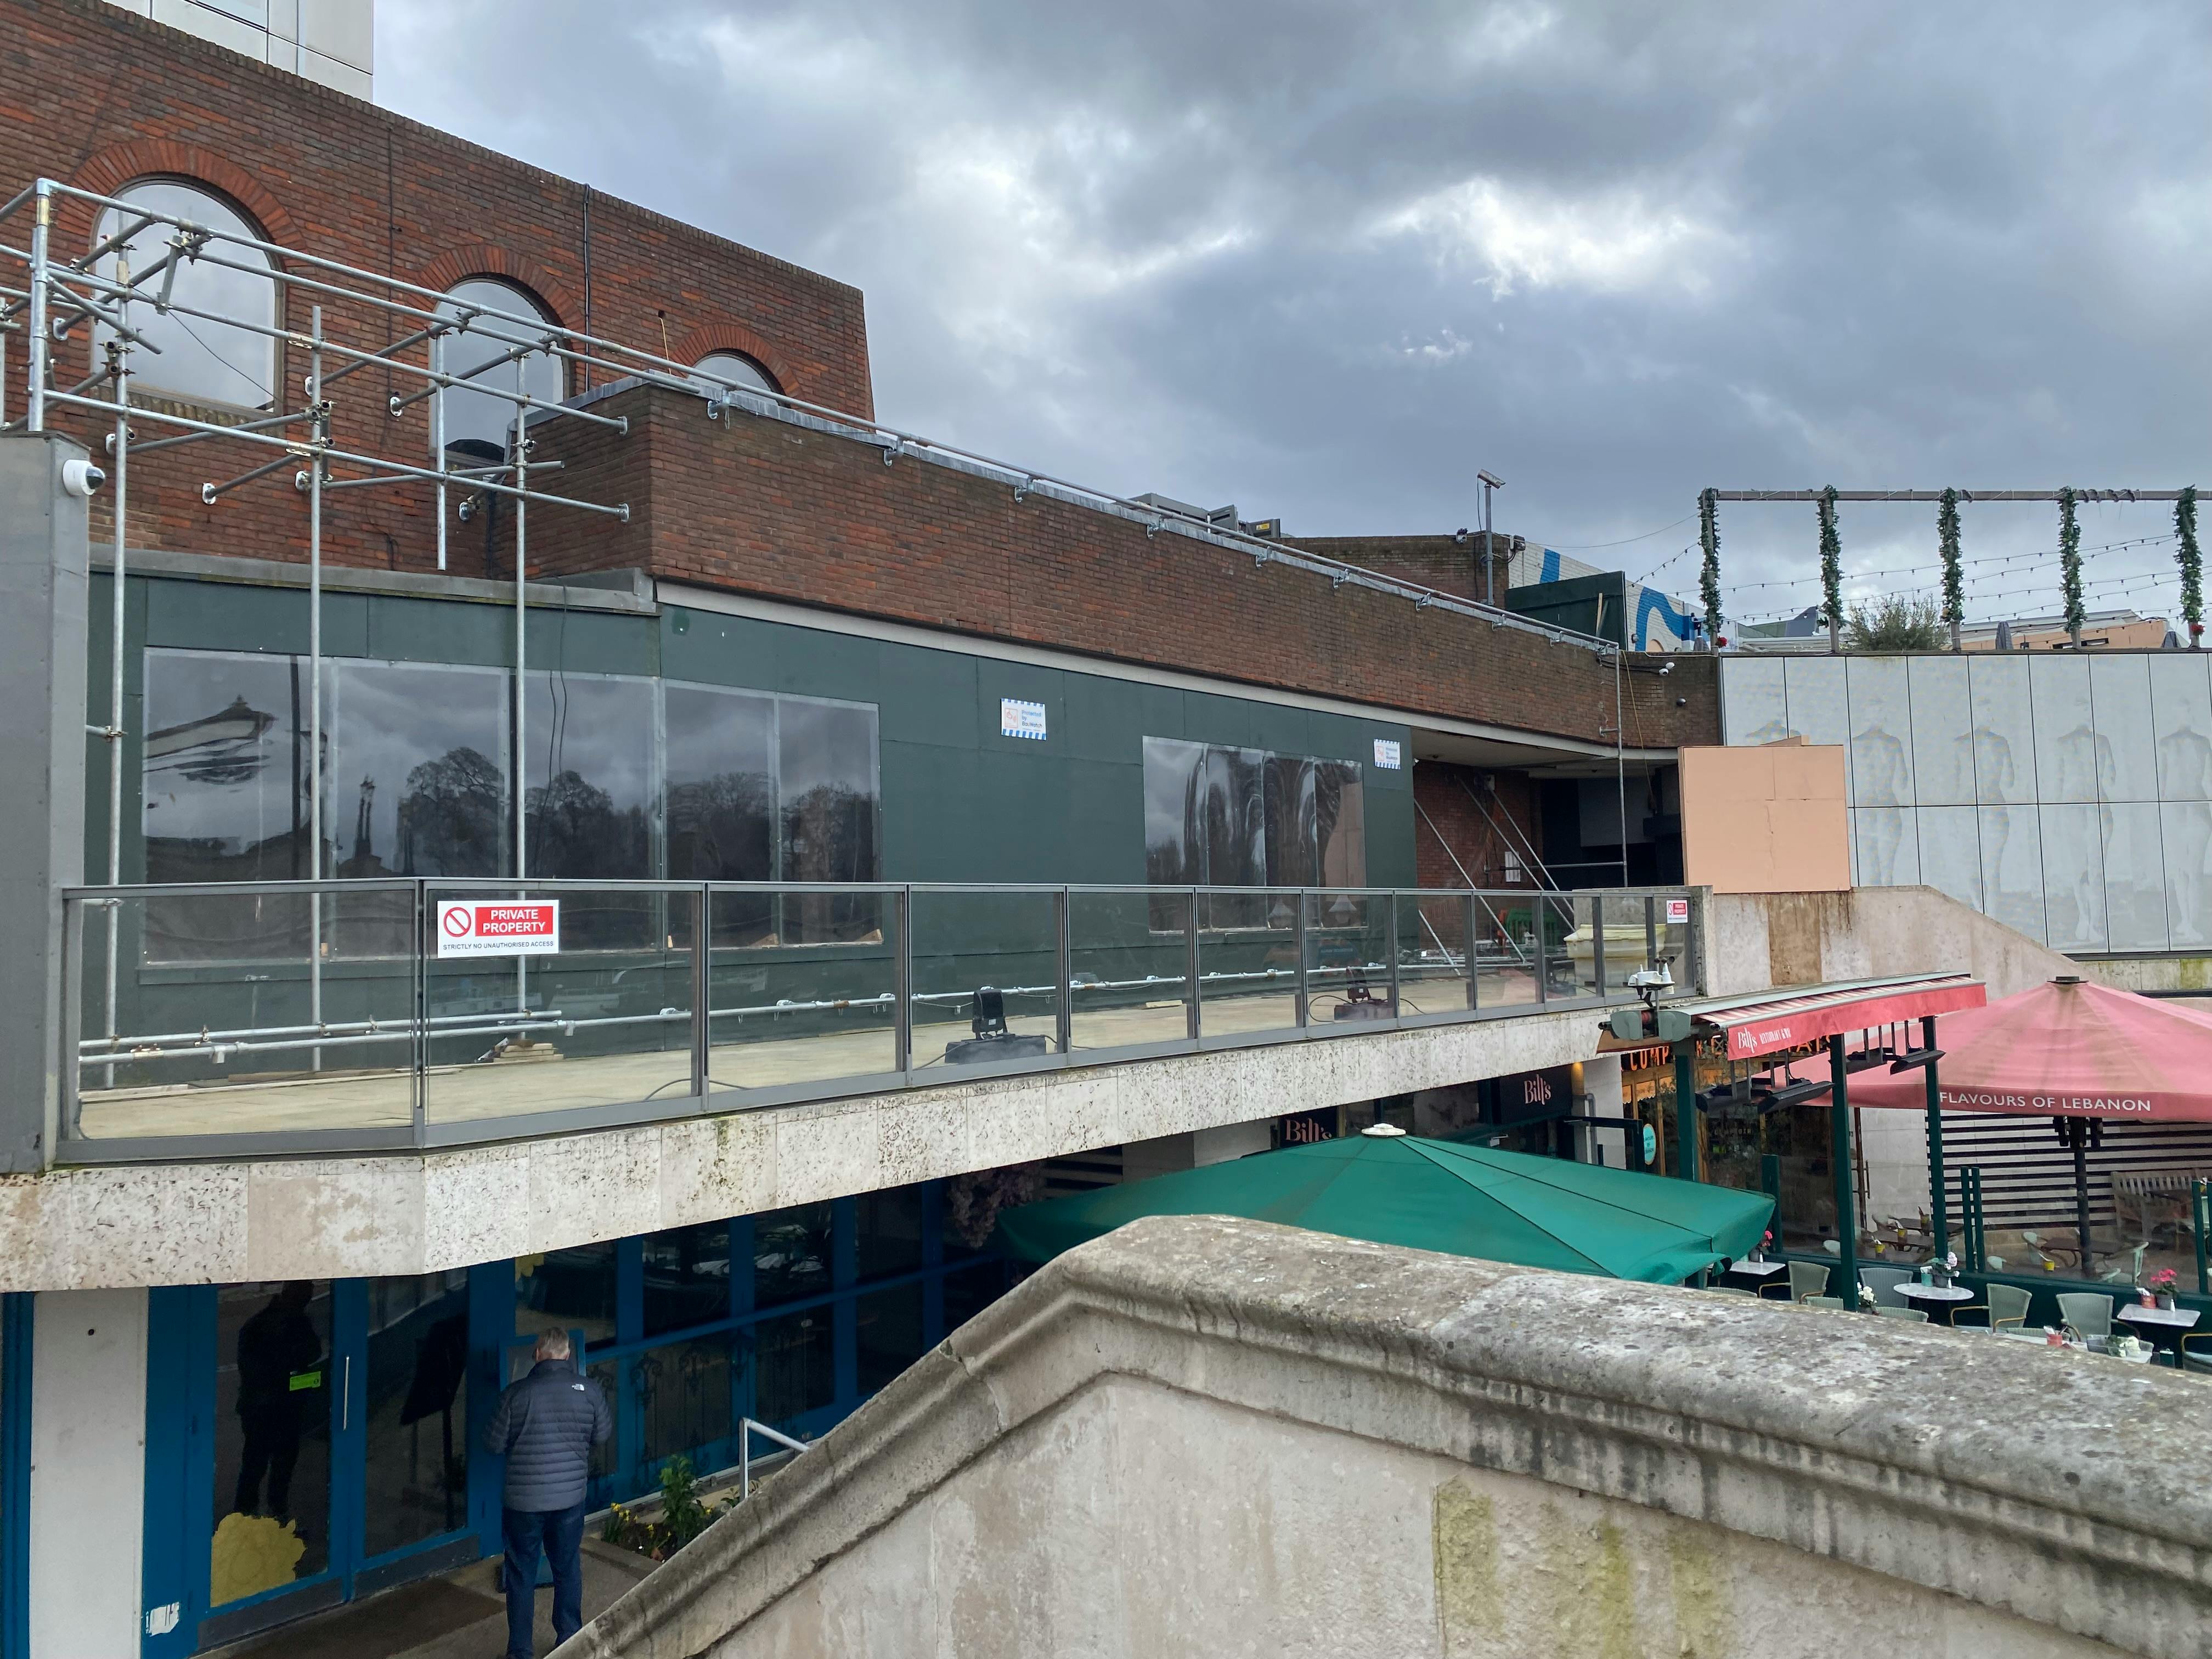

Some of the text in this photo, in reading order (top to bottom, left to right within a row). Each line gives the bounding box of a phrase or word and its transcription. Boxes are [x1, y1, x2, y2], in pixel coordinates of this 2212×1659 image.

[490, 909, 538, 920] PRIVATE
[483, 922, 545, 933] PROPERTY
[1737, 1027, 1758, 1054] Bill's
[1524, 1074, 1551, 1105] Bill's
[1940, 1092, 2151, 1111] FLAVOURS OF LEBANON
